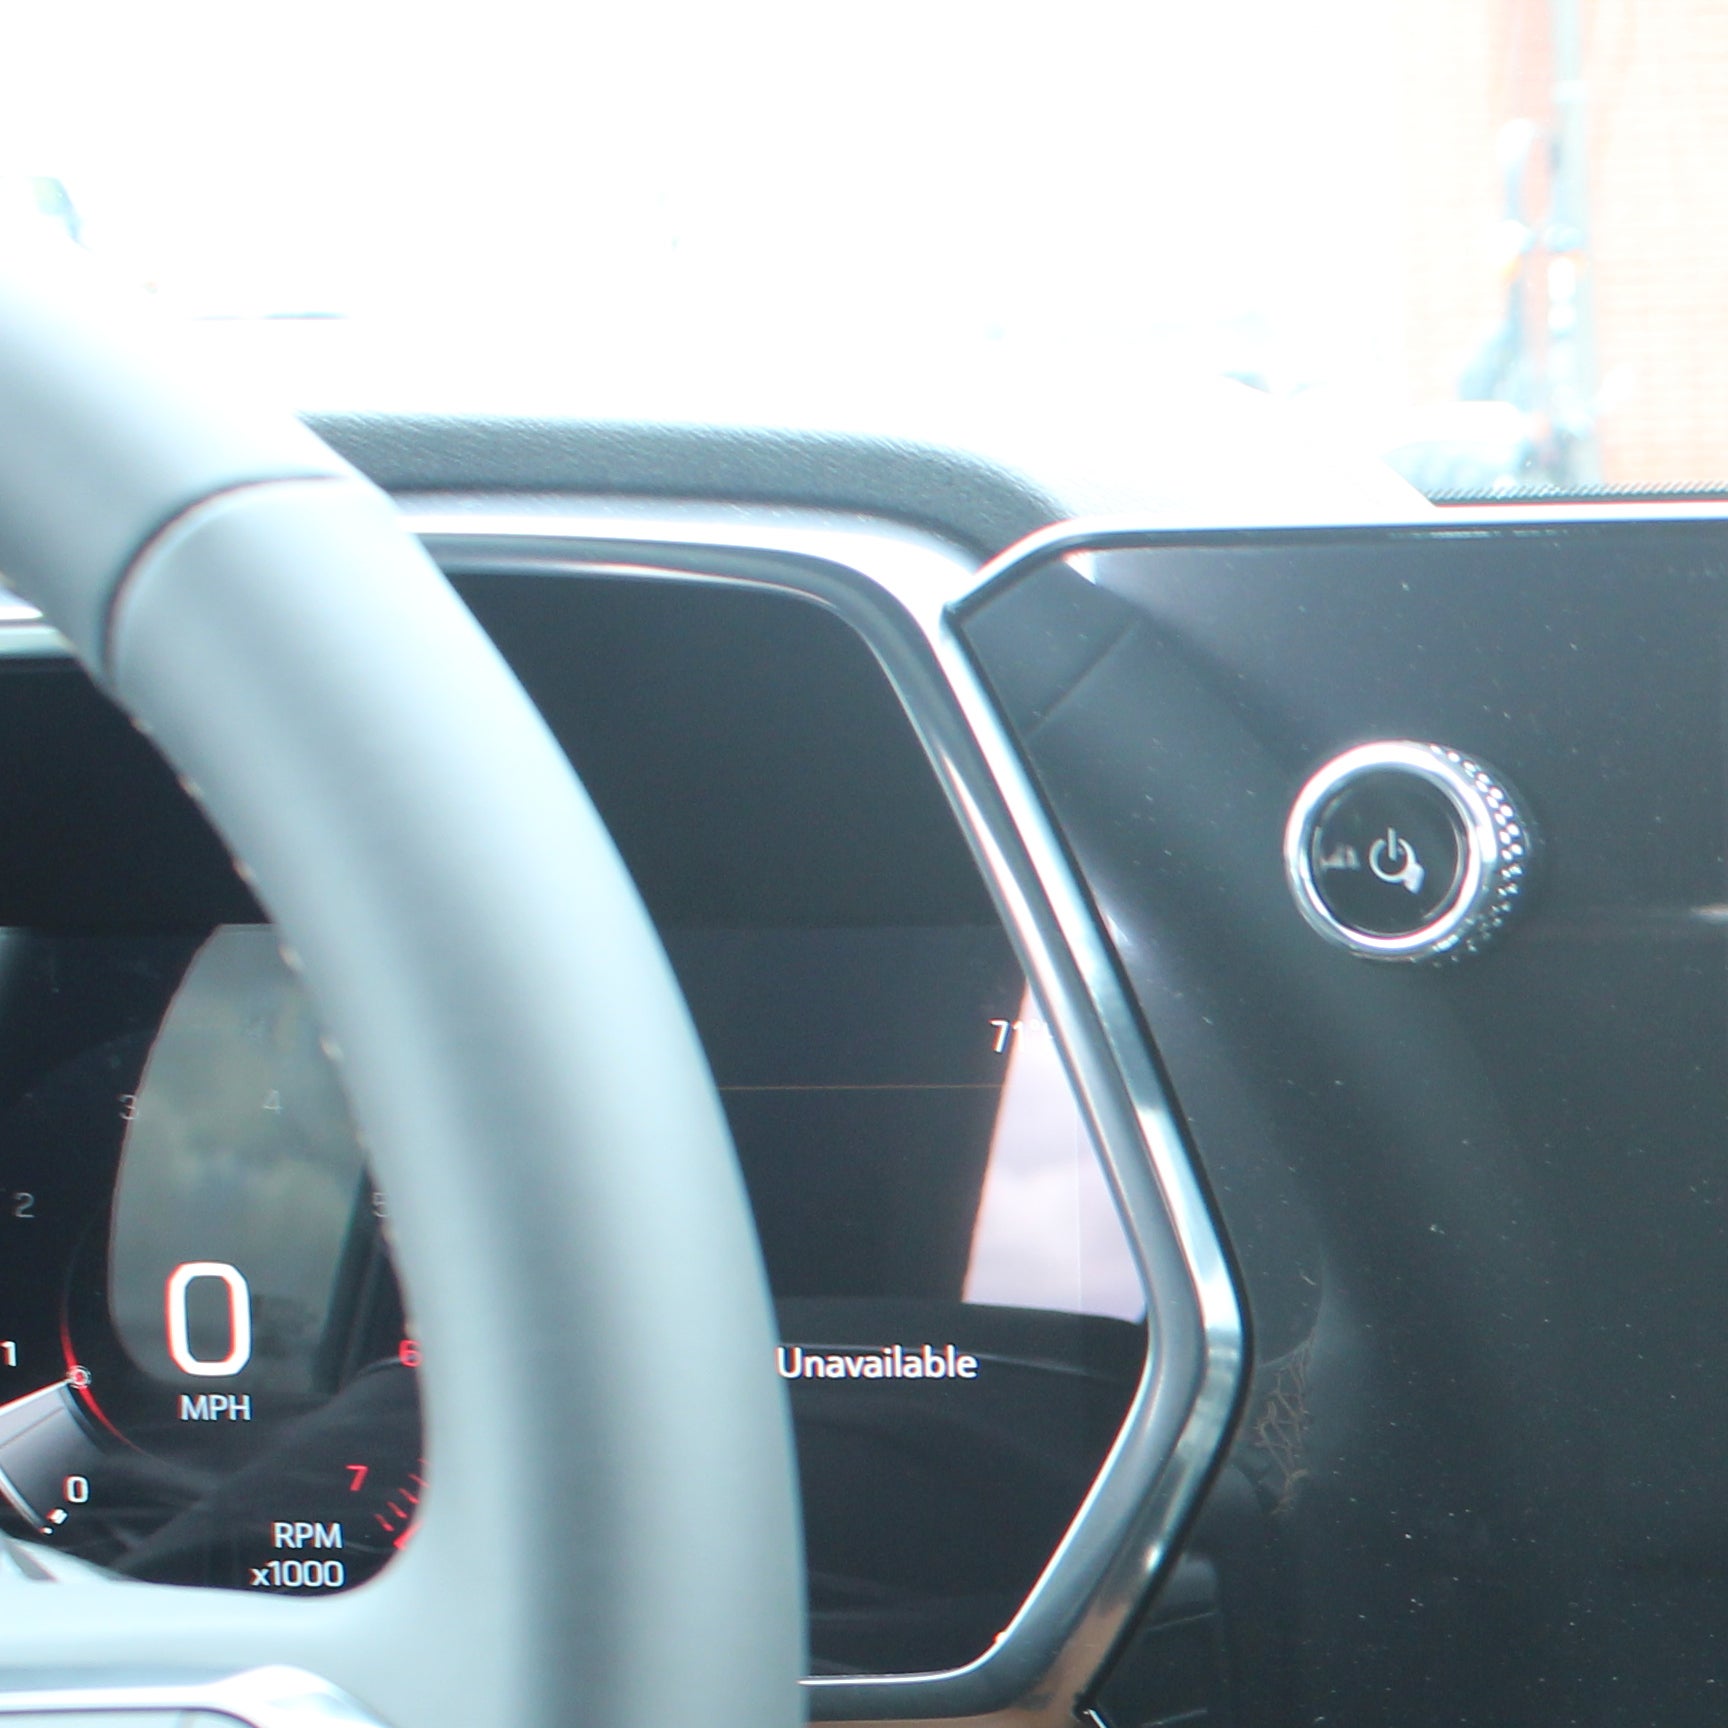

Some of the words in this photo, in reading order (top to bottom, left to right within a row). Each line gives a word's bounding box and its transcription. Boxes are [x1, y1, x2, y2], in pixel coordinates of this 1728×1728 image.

[118, 1094, 140, 1121] 3
[13, 1193, 35, 1218] 2
[165, 1261, 252, 1377] 0
[399, 1340, 422, 1367] 6
[776, 1344, 979, 1378] Unavailable
[179, 1395, 252, 1421] MPH
[64, 1475, 89, 1504] 0
[346, 1464, 369, 1491] 7
[272, 1522, 344, 1549] RPM
[251, 1560, 345, 1587] x1000
